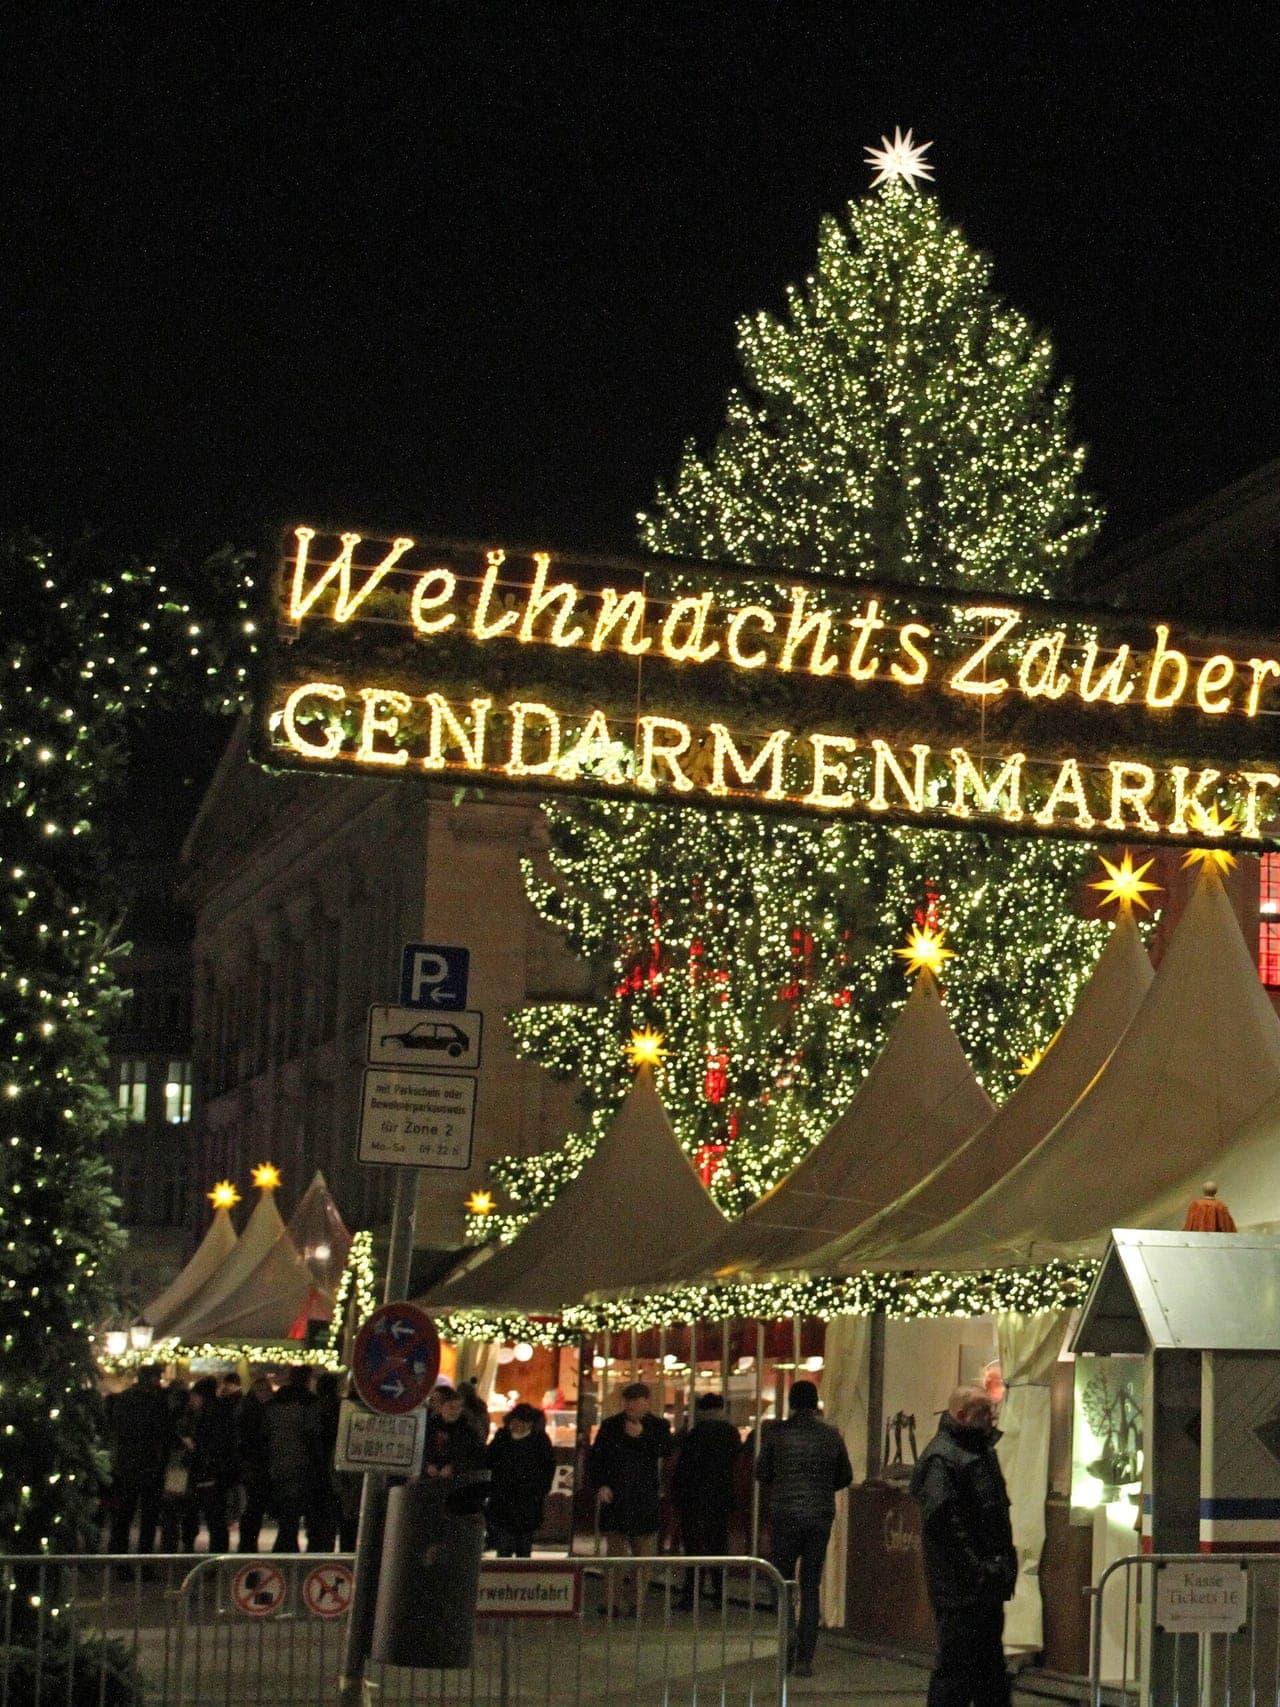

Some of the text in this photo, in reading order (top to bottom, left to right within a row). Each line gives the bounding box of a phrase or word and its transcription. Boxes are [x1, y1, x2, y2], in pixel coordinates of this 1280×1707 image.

[282, 682, 1280, 839] GENDARMENMARKT
[411, 952, 449, 1001] P
[380, 1120, 454, 1137] für Zone 2
[1184, 1573, 1224, 1587] Kasse
[1167, 1588, 1218, 1605] Tickets
